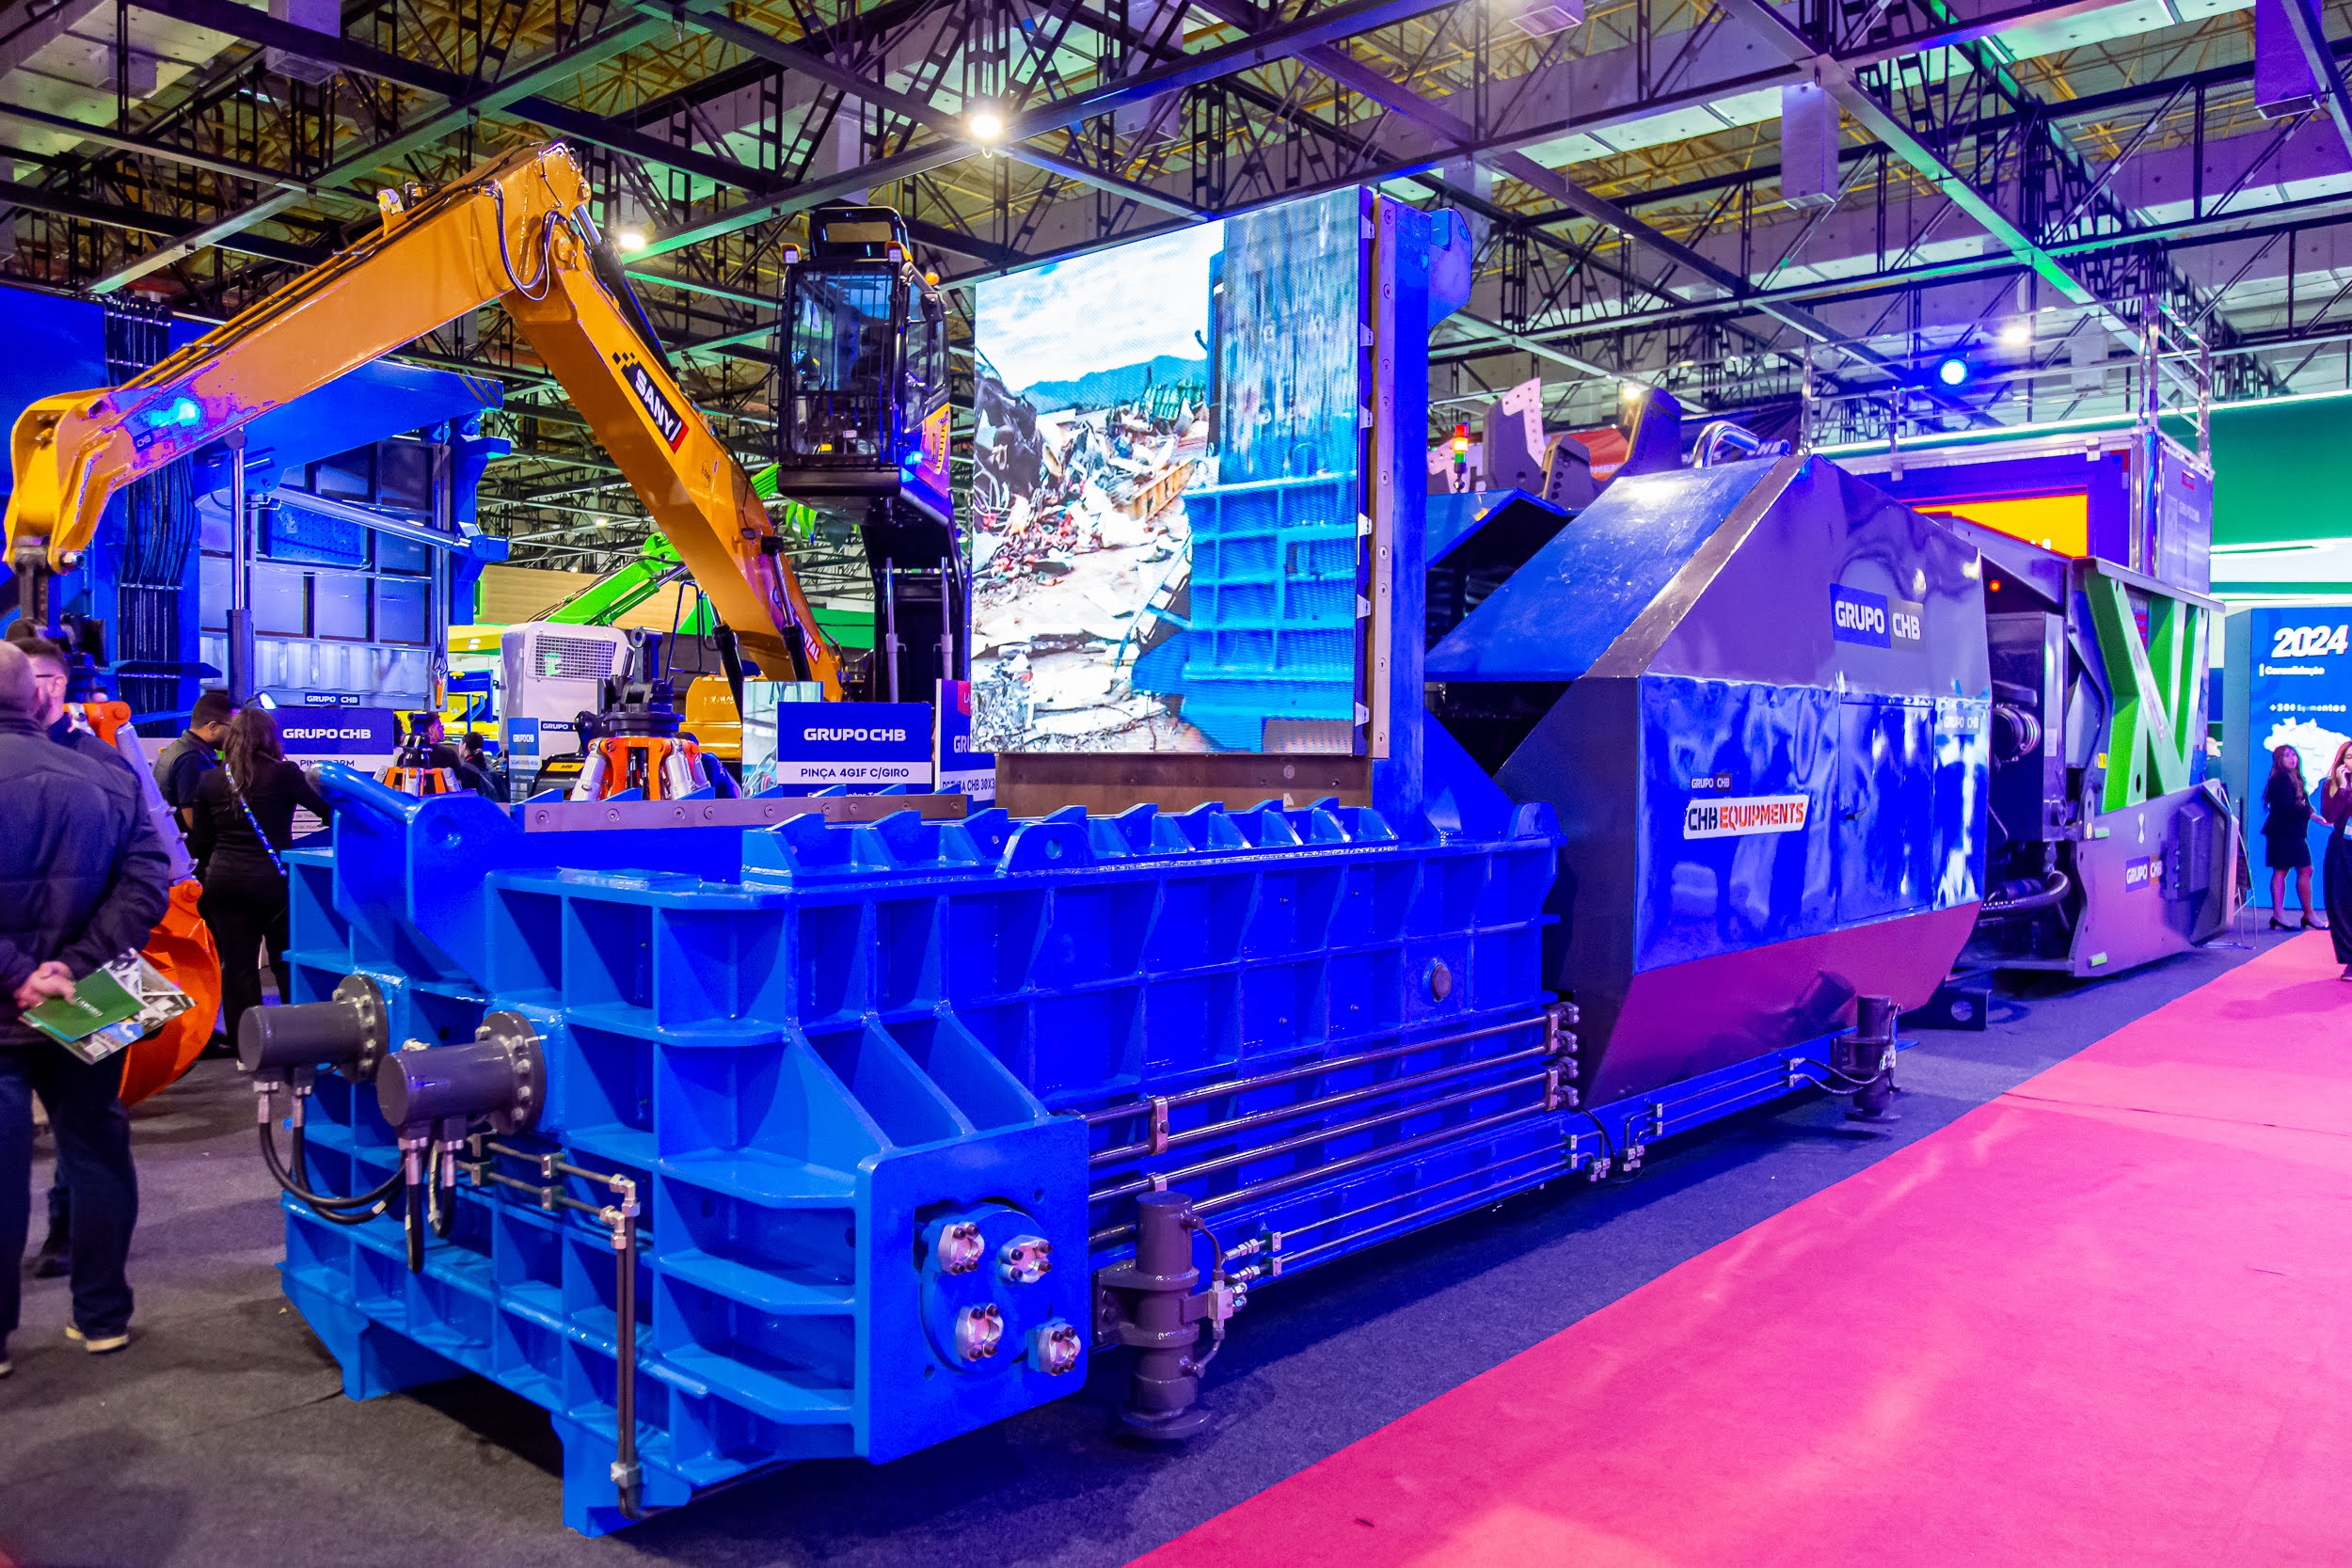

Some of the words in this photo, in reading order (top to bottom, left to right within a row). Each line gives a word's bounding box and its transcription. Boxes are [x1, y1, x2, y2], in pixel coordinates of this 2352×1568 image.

[635, 369, 675, 436] SANY
[1835, 600, 1885, 634] GRUPO
[1892, 612, 1921, 640] CHB
[2271, 625, 2349, 657] 2024
[282, 728, 338, 739] GRUPO
[339, 728, 372, 739] CHB
[803, 728, 868, 742] GRUPO
[869, 728, 907, 742] CHB
[801, 768, 836, 780] PINÇA
[839, 768, 867, 778] 4G1F
[869, 768, 910, 780] C/GIRO
[1691, 778, 1714, 788] GRUPO
[1716, 777, 1730, 788] CHB
[967, 779, 979, 791] CHB
[1720, 802, 1804, 831] EQUIPMENTS
[2126, 863, 2148, 884] GRUPO
[2150, 860, 2163, 878] CHB
